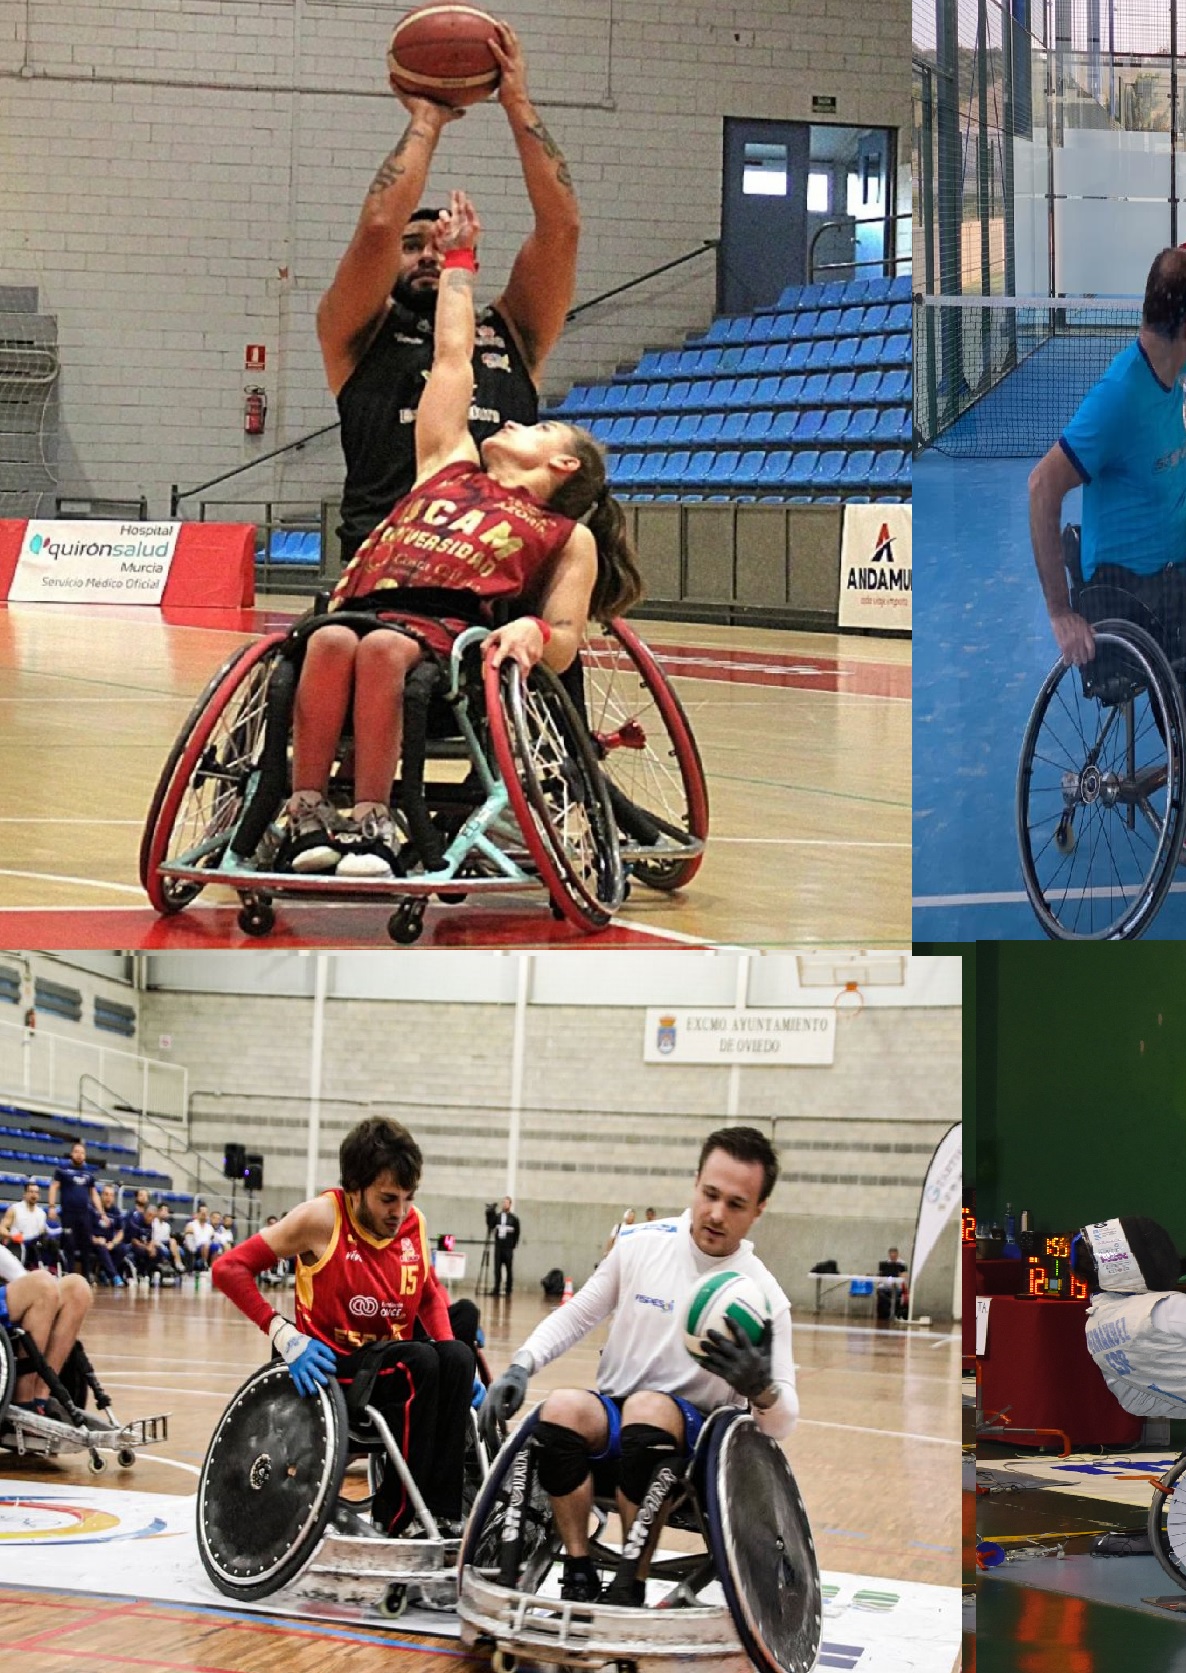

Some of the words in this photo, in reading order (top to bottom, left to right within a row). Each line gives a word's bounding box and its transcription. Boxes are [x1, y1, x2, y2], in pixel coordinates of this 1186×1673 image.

[120, 524, 174, 537] Hospital
[120, 562, 164, 574] Murcia
[42, 577, 84, 588] Servicio
[126, 579, 160, 590] Oficial
[686, 1016, 728, 1032] EXCMO
[731, 1016, 829, 1032] AYUNTAMIENTO
[719, 1038, 734, 1053] DE
[736, 1038, 781, 1053] OVIEDO
[399, 1265, 419, 1295] 15
